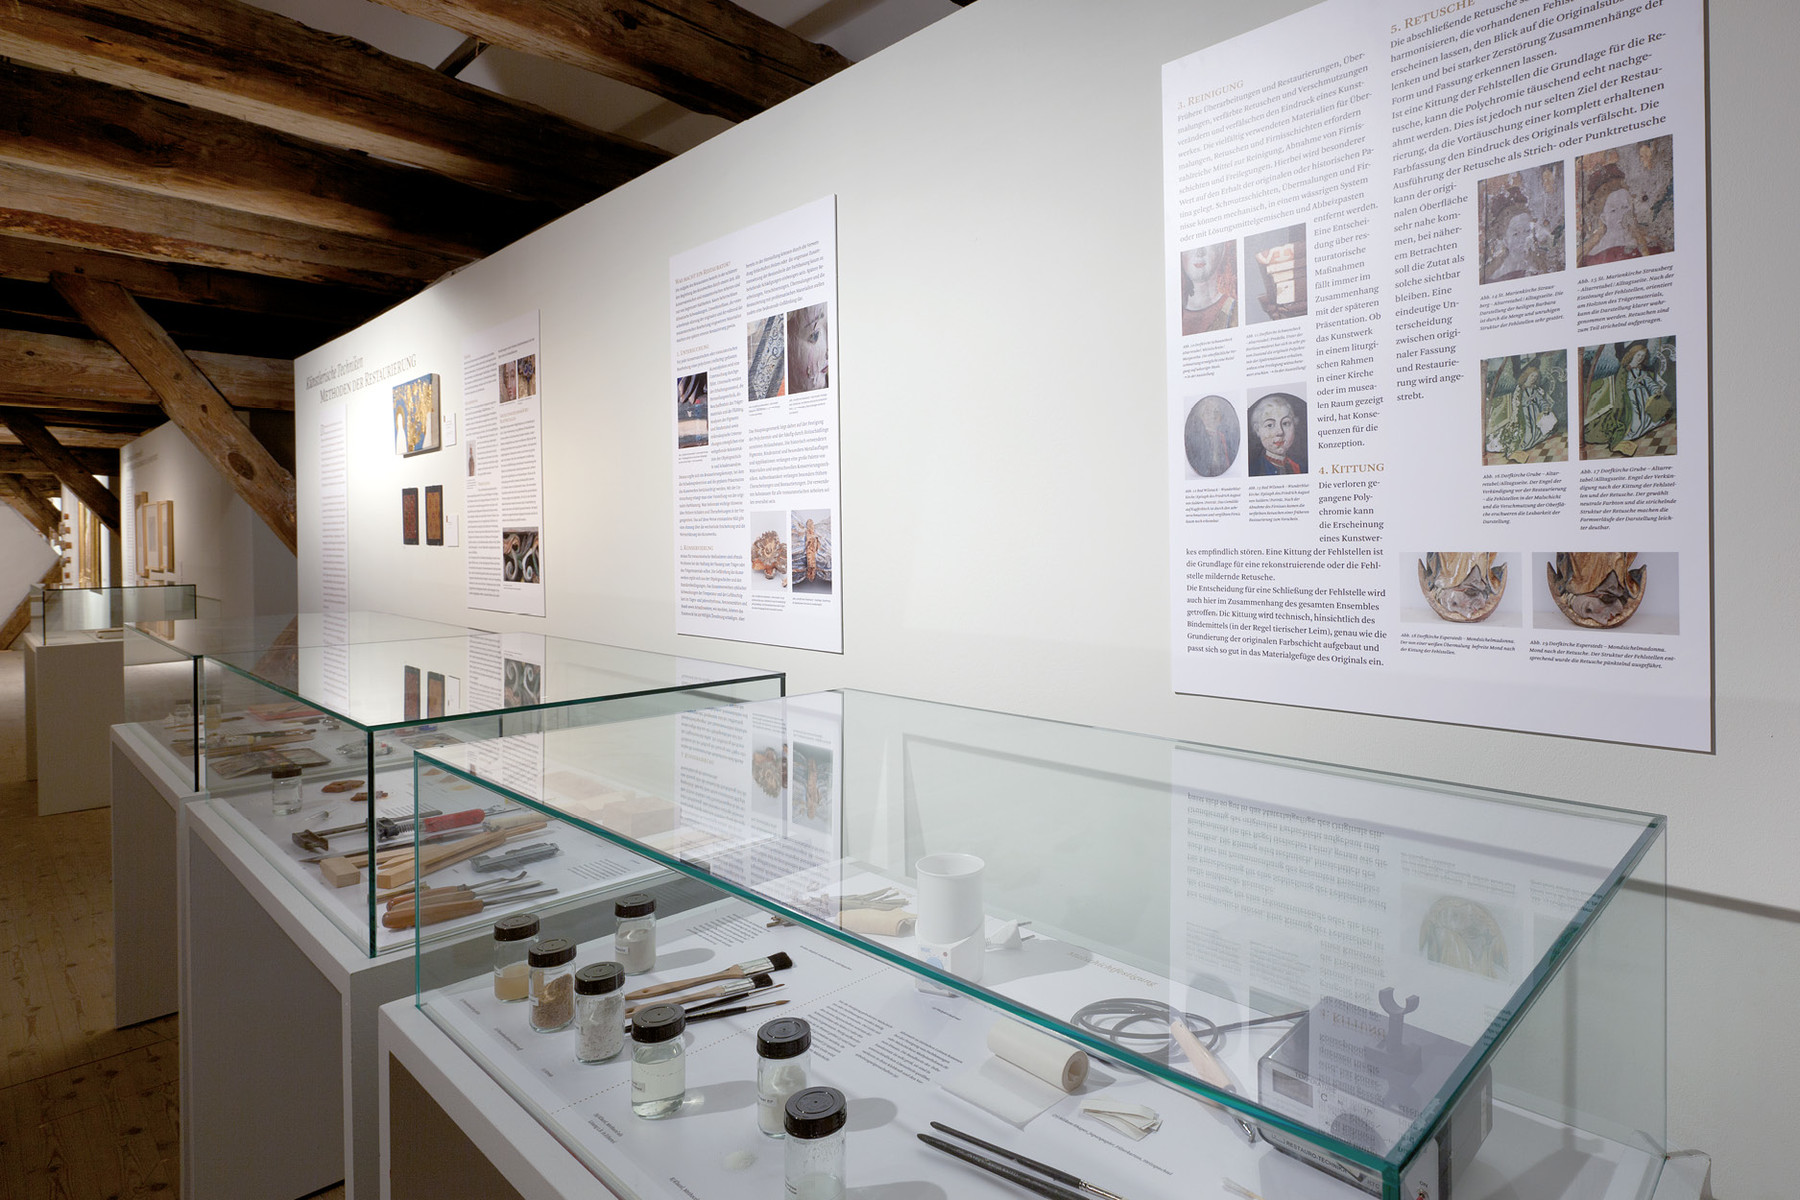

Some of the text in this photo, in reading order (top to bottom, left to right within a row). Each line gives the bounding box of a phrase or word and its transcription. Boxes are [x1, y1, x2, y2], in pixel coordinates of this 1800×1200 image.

[1390, 0, 1476, 34] 5. RETUSCHE
[1390, 0, 1519, 49] Die abschließende Retusche
[1390, 4, 1540, 63] harmonisieren, die vorhandenen
[1390, 16, 1556, 77] erscheinen lassen, den Blick auf die
[1391, 0, 1664, 91] lenken und bei starker Zerstörung Zusammenhänge der
[1392, 33, 1666, 119] Ist eine Kittung der Fehlstellen die Grundlage für die Re-
[1392, 49, 1557, 105] Form und Fassung erkennen lassen.
[1177, 79, 1244, 110] 3. REINIGUNG
[1178, 65, 1368, 134] malungen, verfärbte Retuschen und Verschmutzungen
[1392, 53, 1652, 133] tusche, kann die Polychromie täuschend echt nachge-
[1392, 67, 1663, 148] ahmt werden. Dies ist jedoch nur selten Ziel der Restau-
[1393, 82, 1665, 162] rierung, da die Vortäuschung einer komplett erhaltenen
[1393, 100, 1660, 176] Farbfassung den Eindruck des Originals verfälscht. Die
[1393, 116, 1666, 190] Ausführung der Retusche als Strich- oder Punktretusche
[1394, 195, 1469, 218] nalen Oberfläche
[1394, 254, 1465, 275] soll die Zutat als
[1394, 271, 1461, 289] solche sichtbar
[1314, 286, 1379, 303] Zusammenhang
[1315, 327, 1373, 343] das Kunstwerk
[1316, 312, 1382, 330] Präsentation. Ob
[1395, 328, 1461, 345] zwischen origi-
[352, 377, 364, 393] DER
[365, 354, 417, 387] RESTAURIERUNG
[1396, 358, 1460, 373] und Restaurie-
[1318, 463, 1384, 475] 4. KITTUNG
[1318, 520, 1384, 530] die Erscheinung
[1186, 572, 1276, 581] stelle mildernde Retusche.
[1186, 584, 1386, 597] Die Entscheidung für eine Schließung der Fehlstelle wird
[1186, 596, 1380, 611] auch hier im Zusammenhang des gesamten Ensembles
